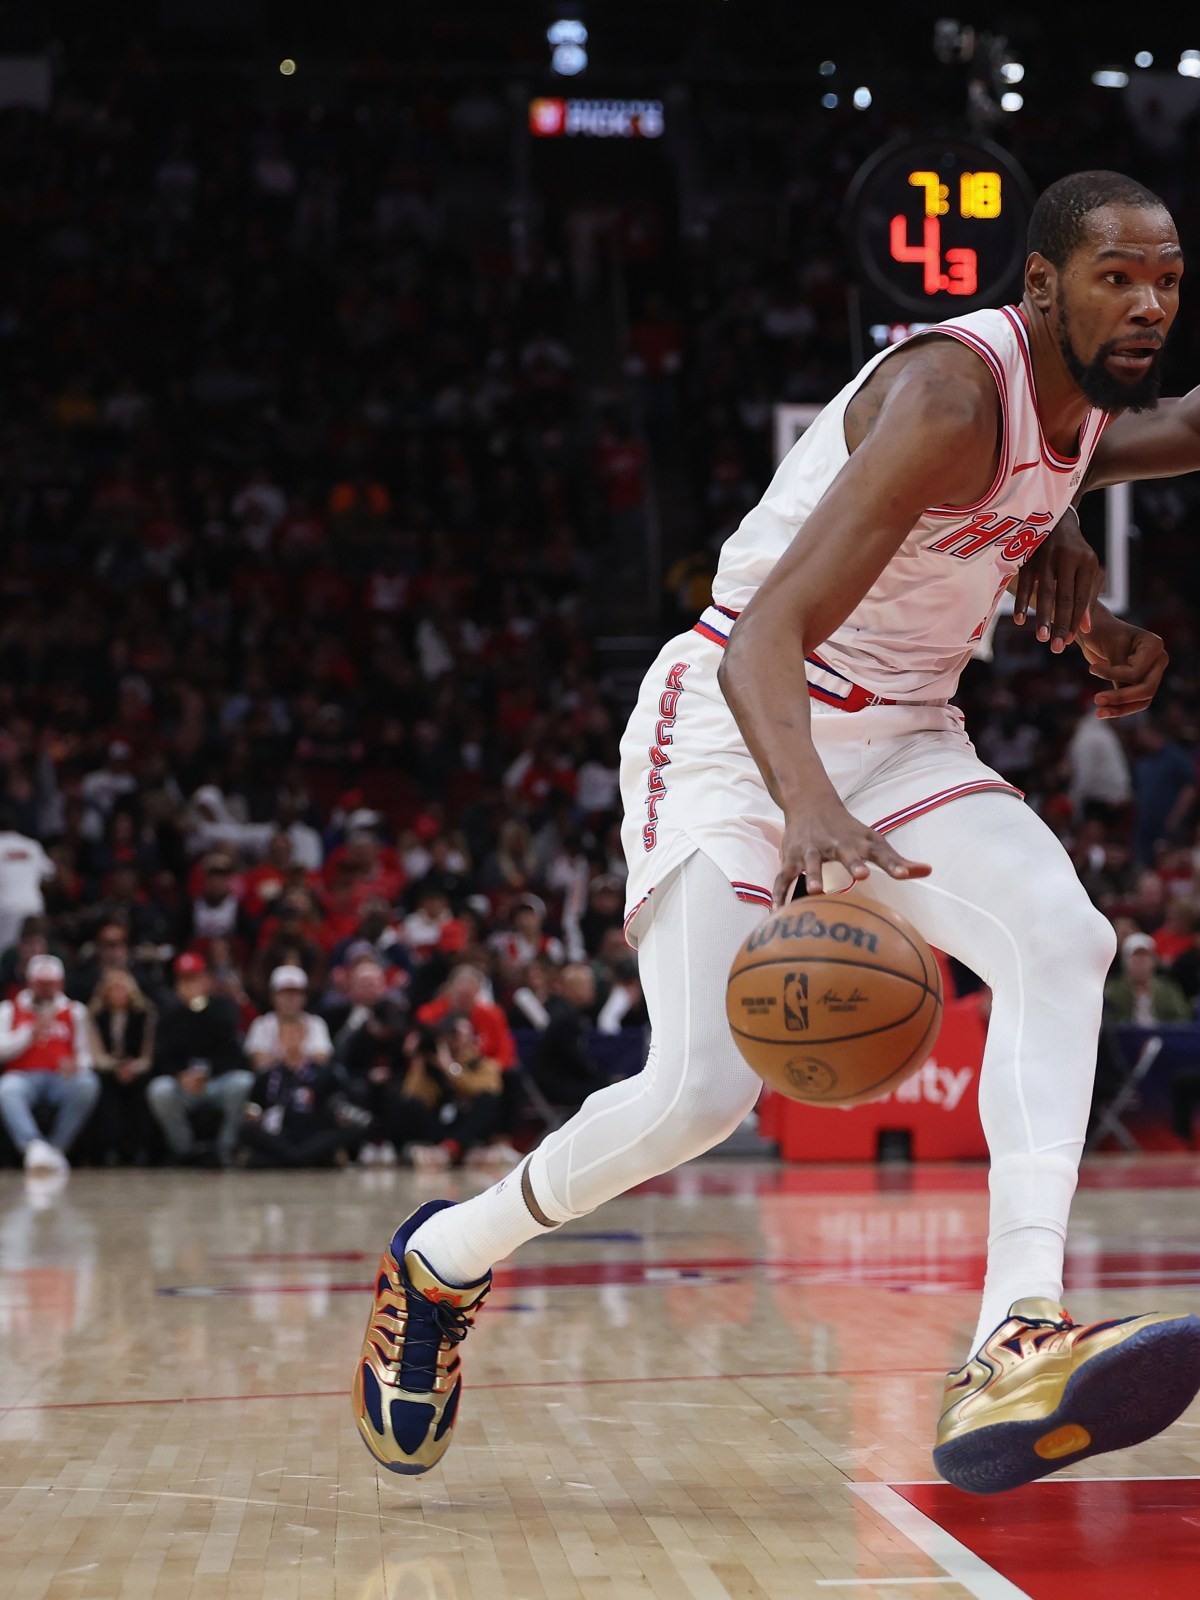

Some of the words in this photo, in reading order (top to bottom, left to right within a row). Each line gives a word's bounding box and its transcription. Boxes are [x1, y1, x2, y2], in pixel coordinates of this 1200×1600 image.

[908, 171, 1002, 219] 7:18
[642, 661, 690, 853] ROCKETS
[746, 910, 879, 954] Wilson
